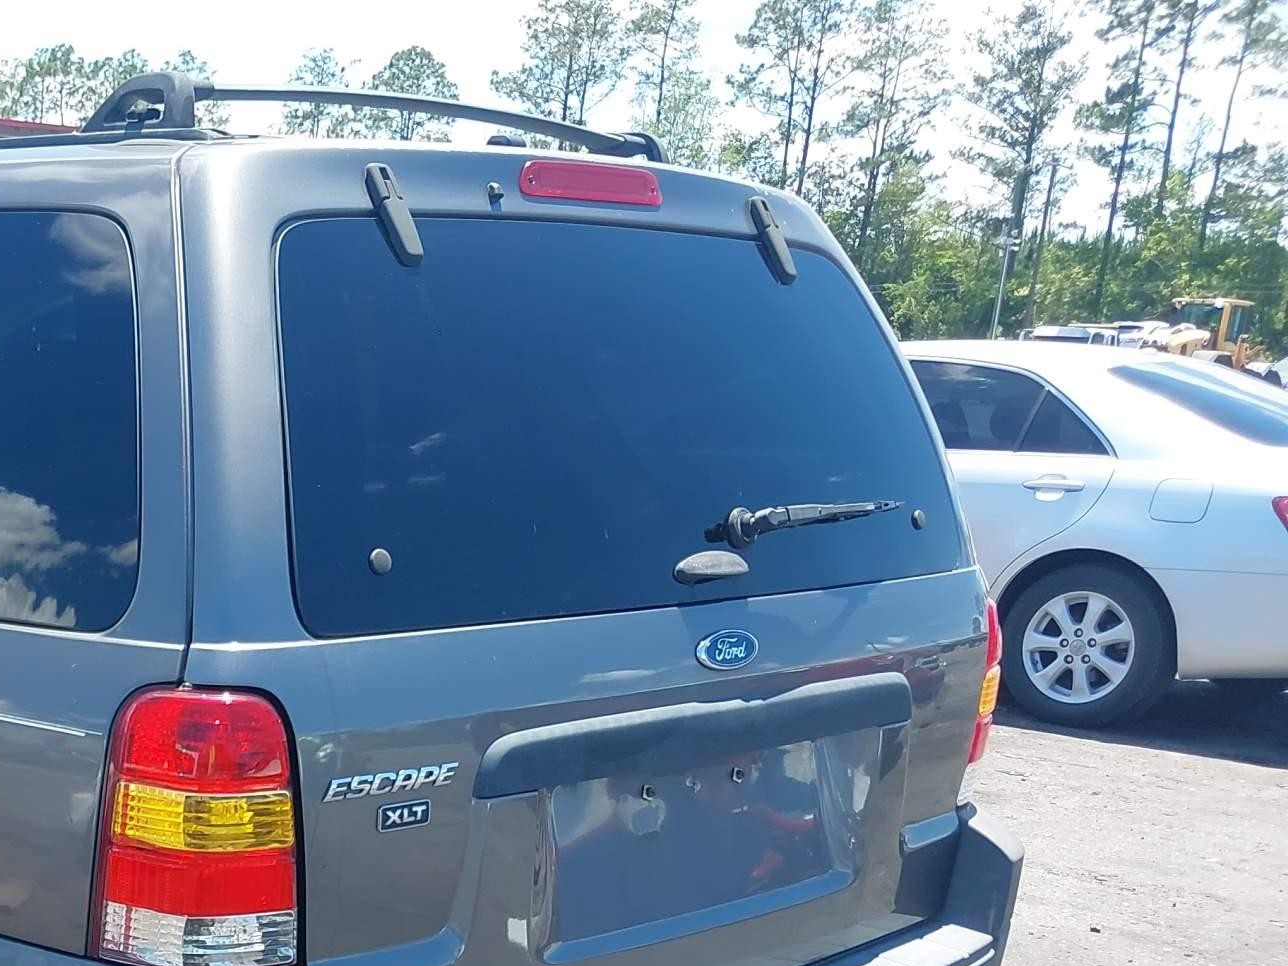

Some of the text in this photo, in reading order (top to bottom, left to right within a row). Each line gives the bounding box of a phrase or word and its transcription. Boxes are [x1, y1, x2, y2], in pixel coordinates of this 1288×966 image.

[715, 637, 747, 661] Ford
[322, 761, 459, 803] ESCAPE
[384, 805, 427, 826] XLT
